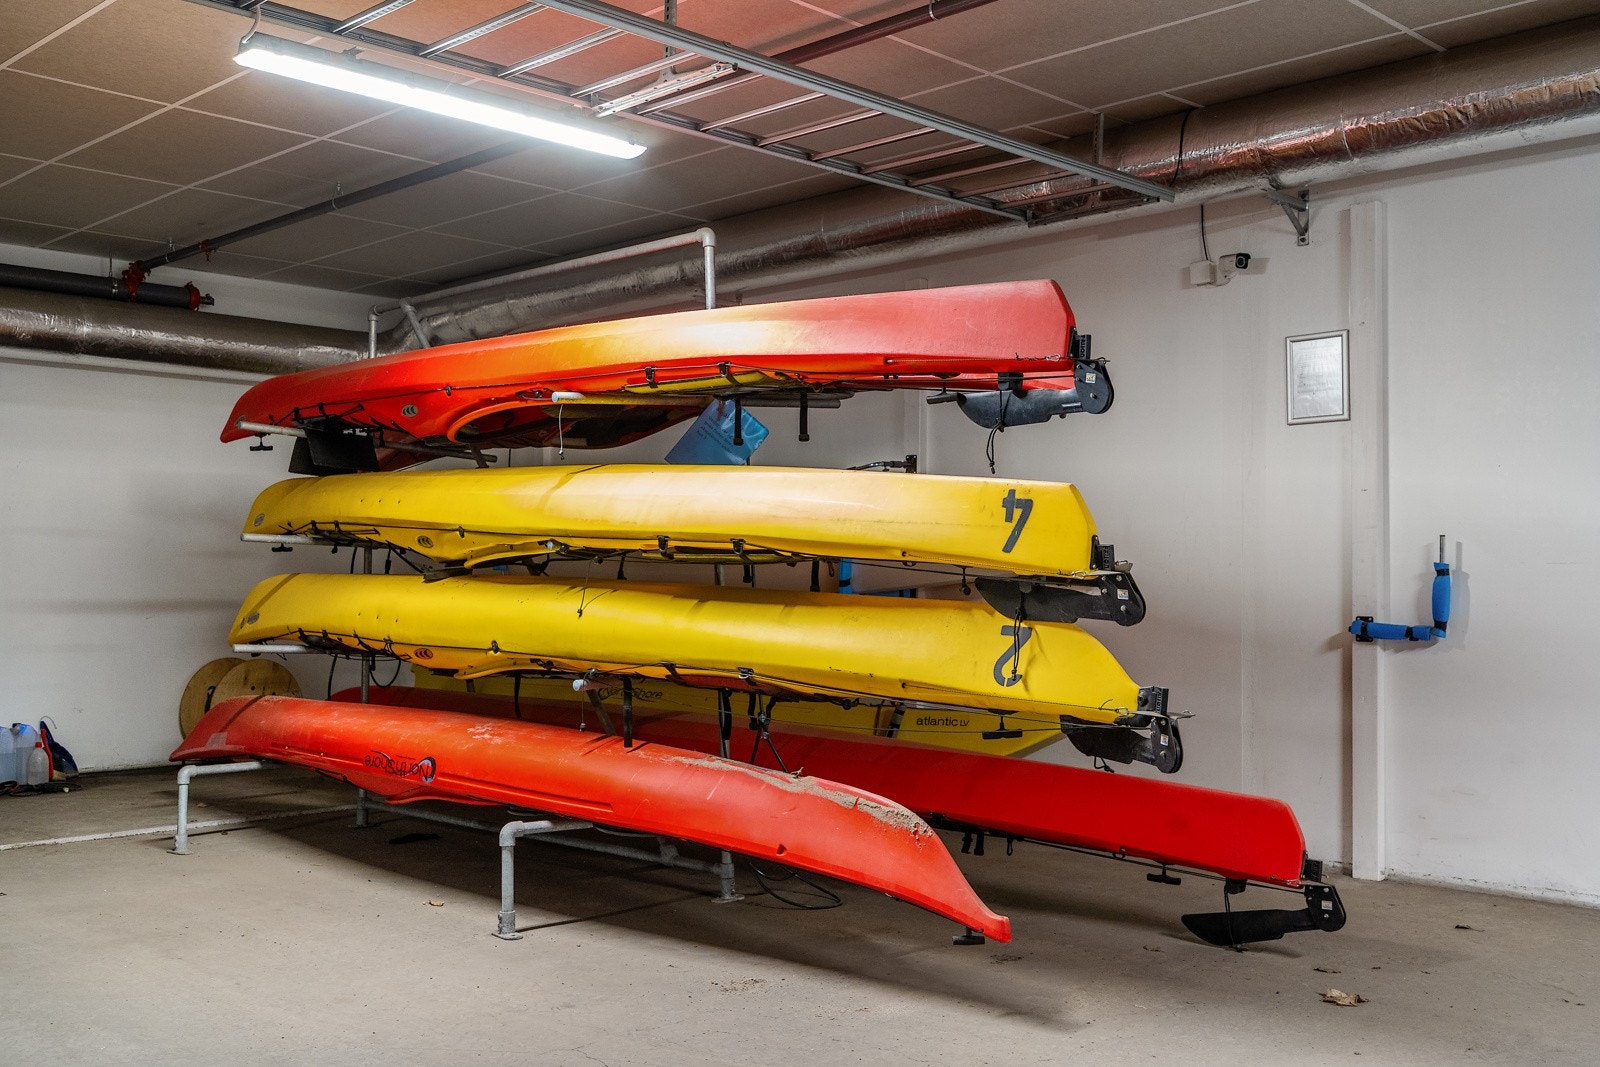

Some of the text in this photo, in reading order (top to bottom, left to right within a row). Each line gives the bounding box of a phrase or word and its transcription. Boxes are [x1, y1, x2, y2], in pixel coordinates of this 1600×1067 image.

[1002, 489, 1033, 553] 4
[994, 625, 1032, 687] 2
[916, 716, 959, 727] atlantic
